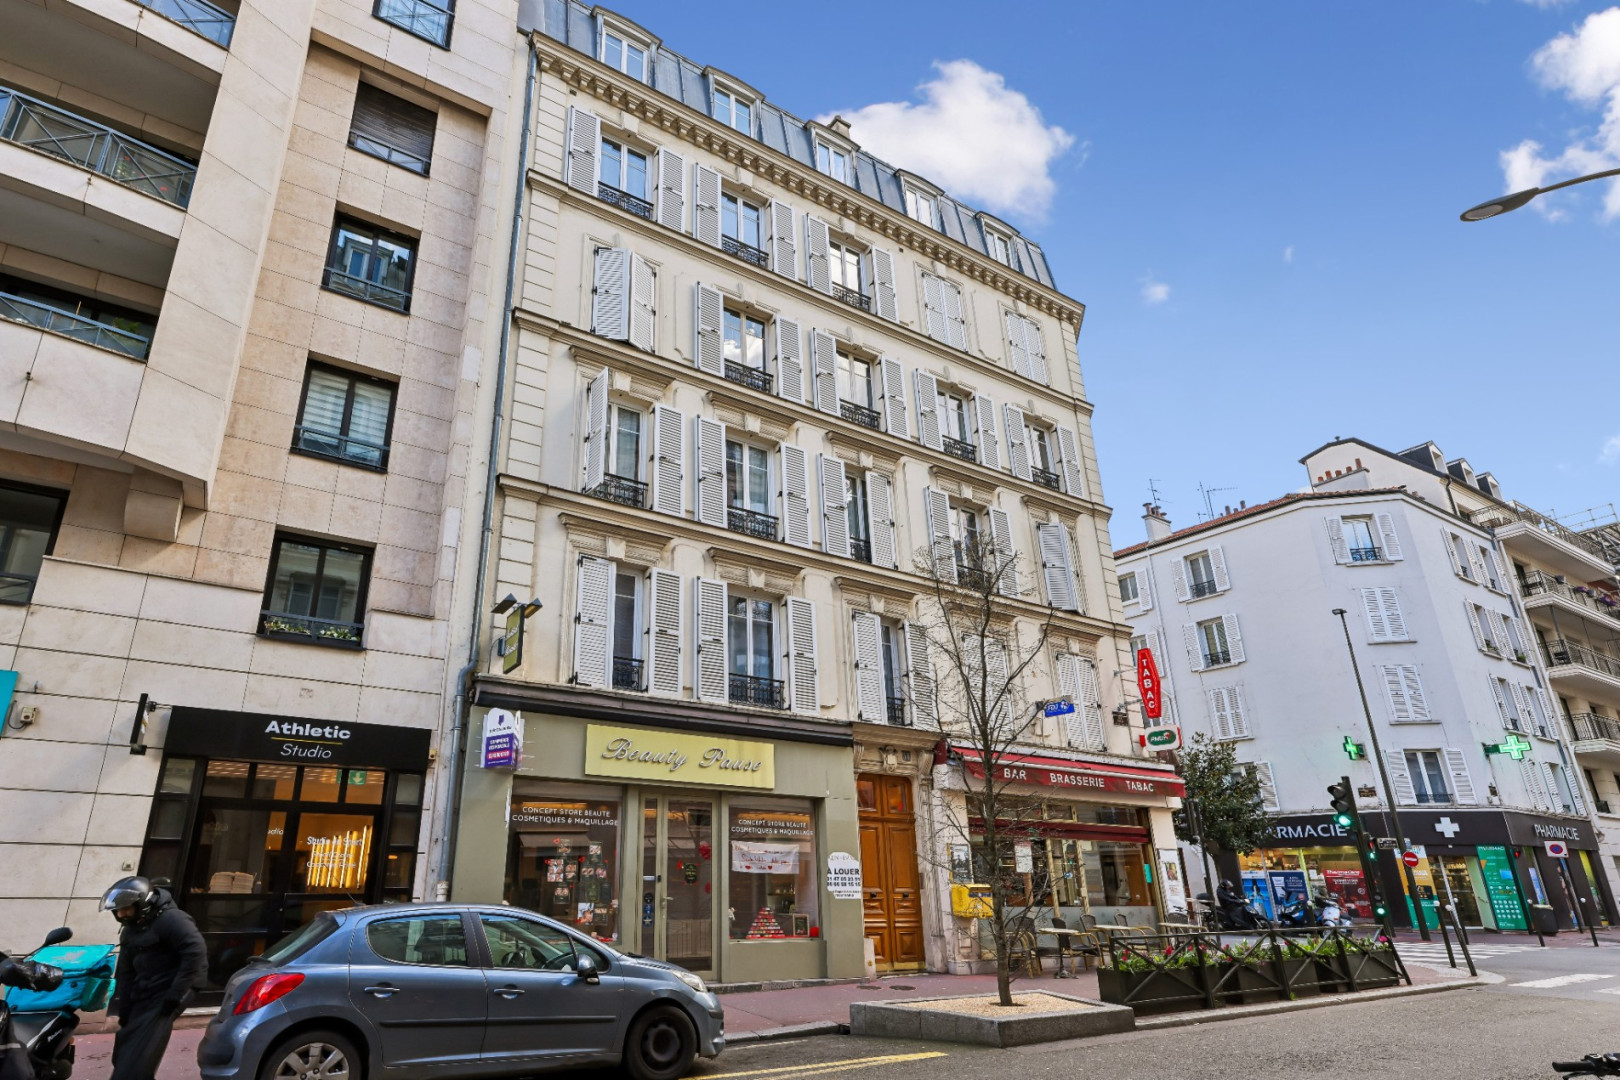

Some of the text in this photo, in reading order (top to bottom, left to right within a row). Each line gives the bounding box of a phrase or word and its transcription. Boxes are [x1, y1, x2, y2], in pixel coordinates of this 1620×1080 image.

[1141, 659, 1156, 709] TABAC
[264, 720, 351, 739] Athletic
[280, 743, 332, 759] Studio
[601, 737, 762, 772] Beauty Pause
[1003, 768, 1154, 792] BAR BRASSERIE TABAC
[522, 806, 558, 815] CONCEPT
[559, 808, 583, 816] STORE
[574, 818, 619, 826] MAQUILLAGE
[1533, 823, 1580, 841] PHARMACIE
[834, 868, 860, 876] LOUER
